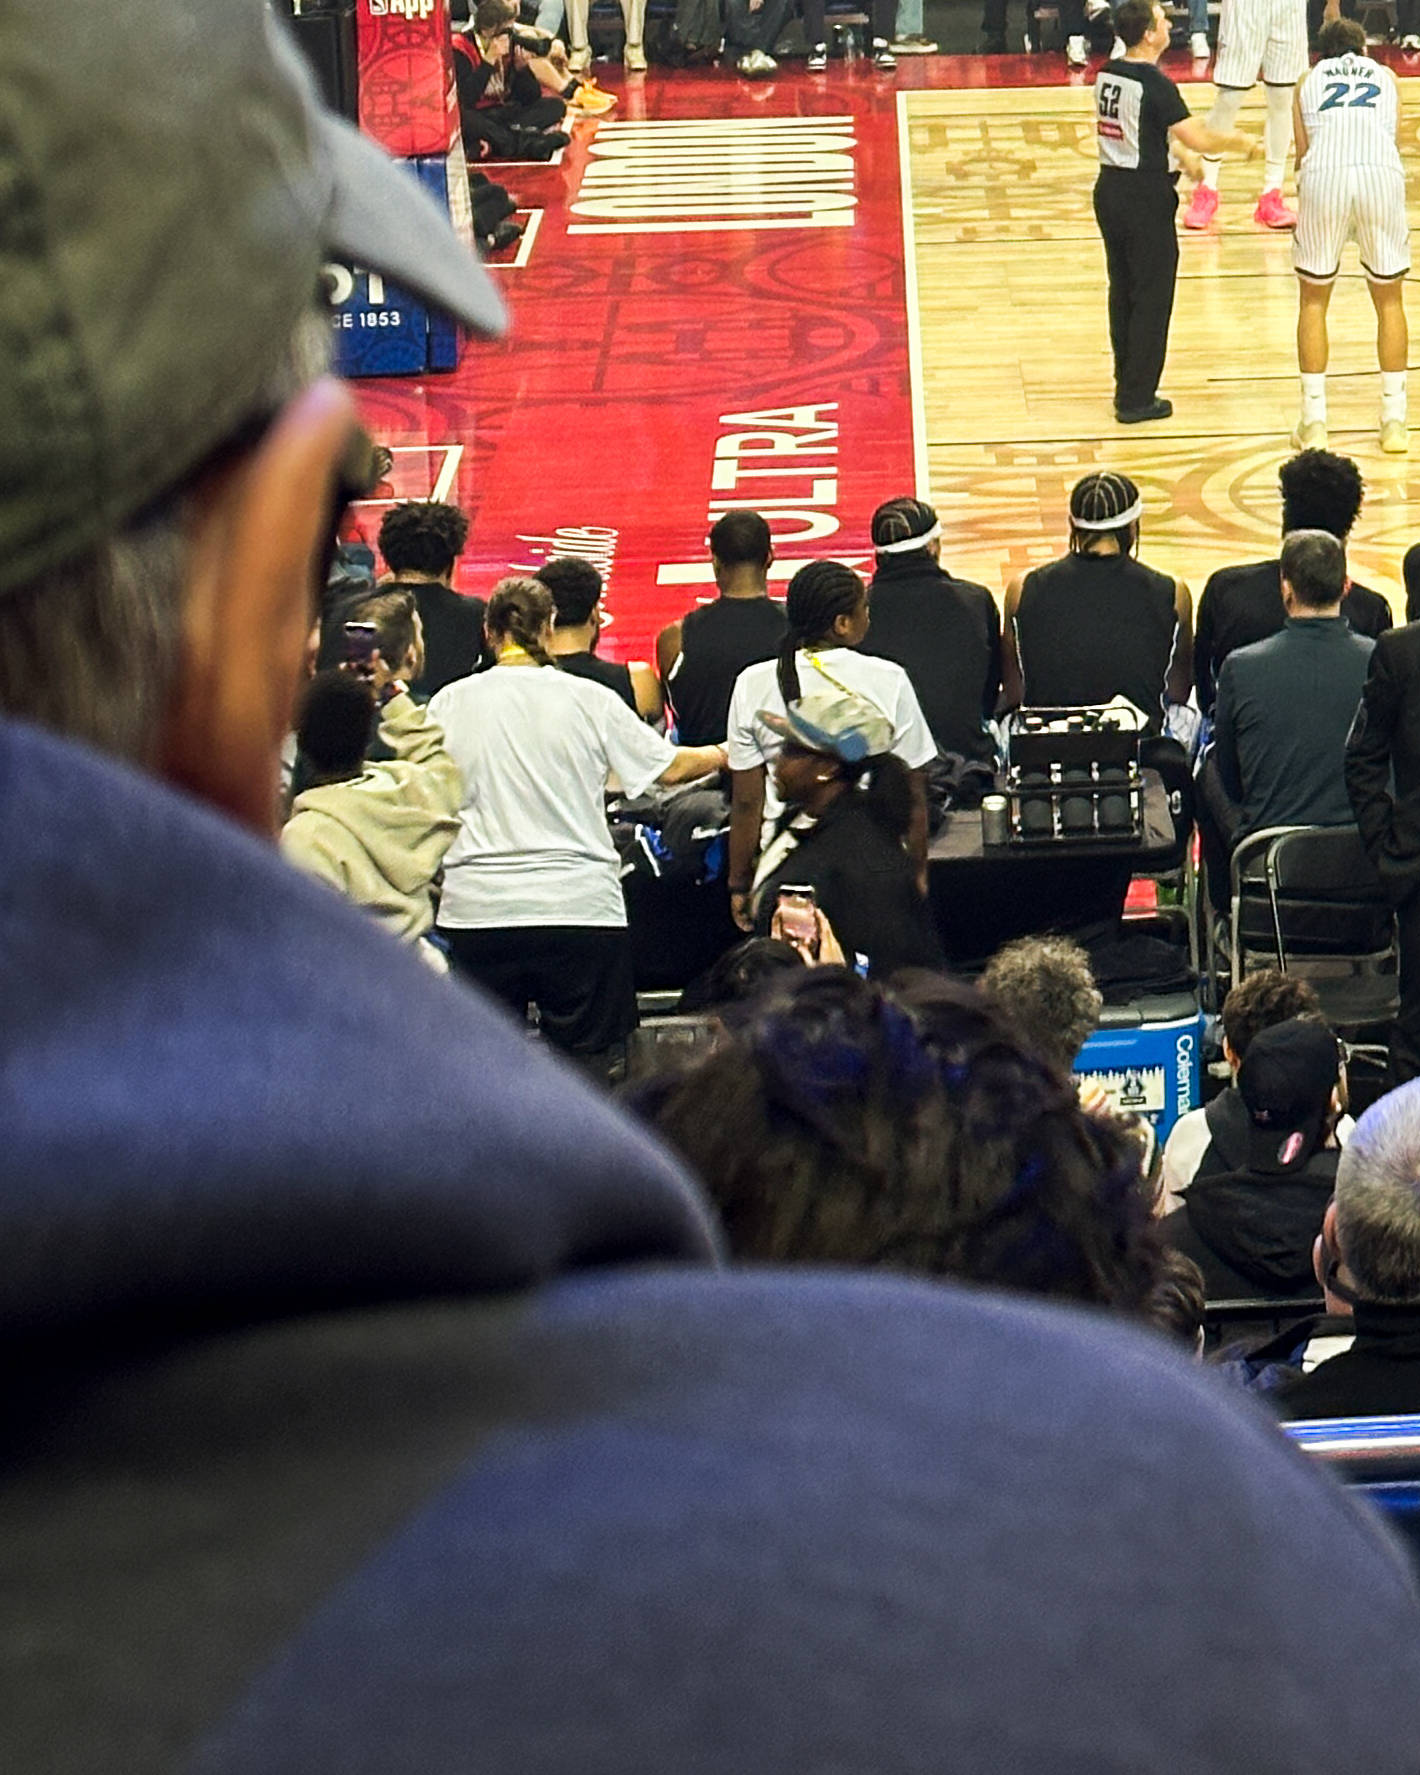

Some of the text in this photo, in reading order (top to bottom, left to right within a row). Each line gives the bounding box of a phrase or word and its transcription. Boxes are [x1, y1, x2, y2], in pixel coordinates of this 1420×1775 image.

[1098, 81, 1122, 120] 52
[1317, 82, 1381, 112] 22
[566, 114, 859, 236] LONDON
[359, 310, 401, 329] 1853
[704, 401, 840, 548] ULTRA
[1175, 1034, 1194, 1116] Colema
